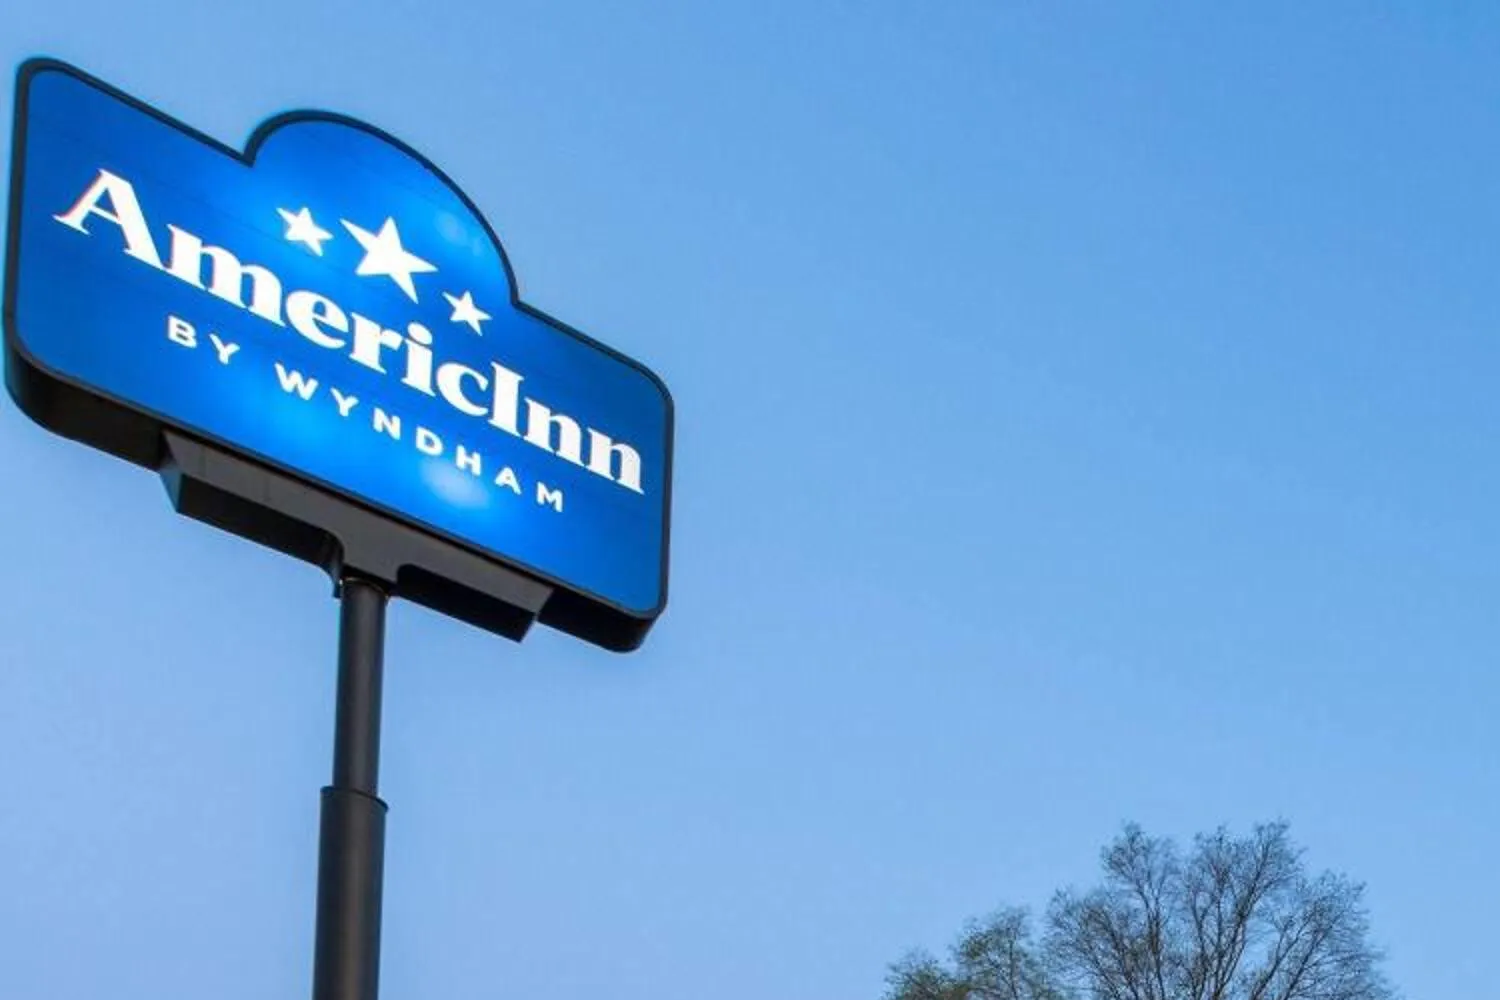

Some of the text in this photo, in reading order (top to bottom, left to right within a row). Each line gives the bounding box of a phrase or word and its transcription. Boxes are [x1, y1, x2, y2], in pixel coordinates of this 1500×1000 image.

[53, 168, 644, 495] AmericInn
[167, 315, 564, 512] BY WYNDHAM
